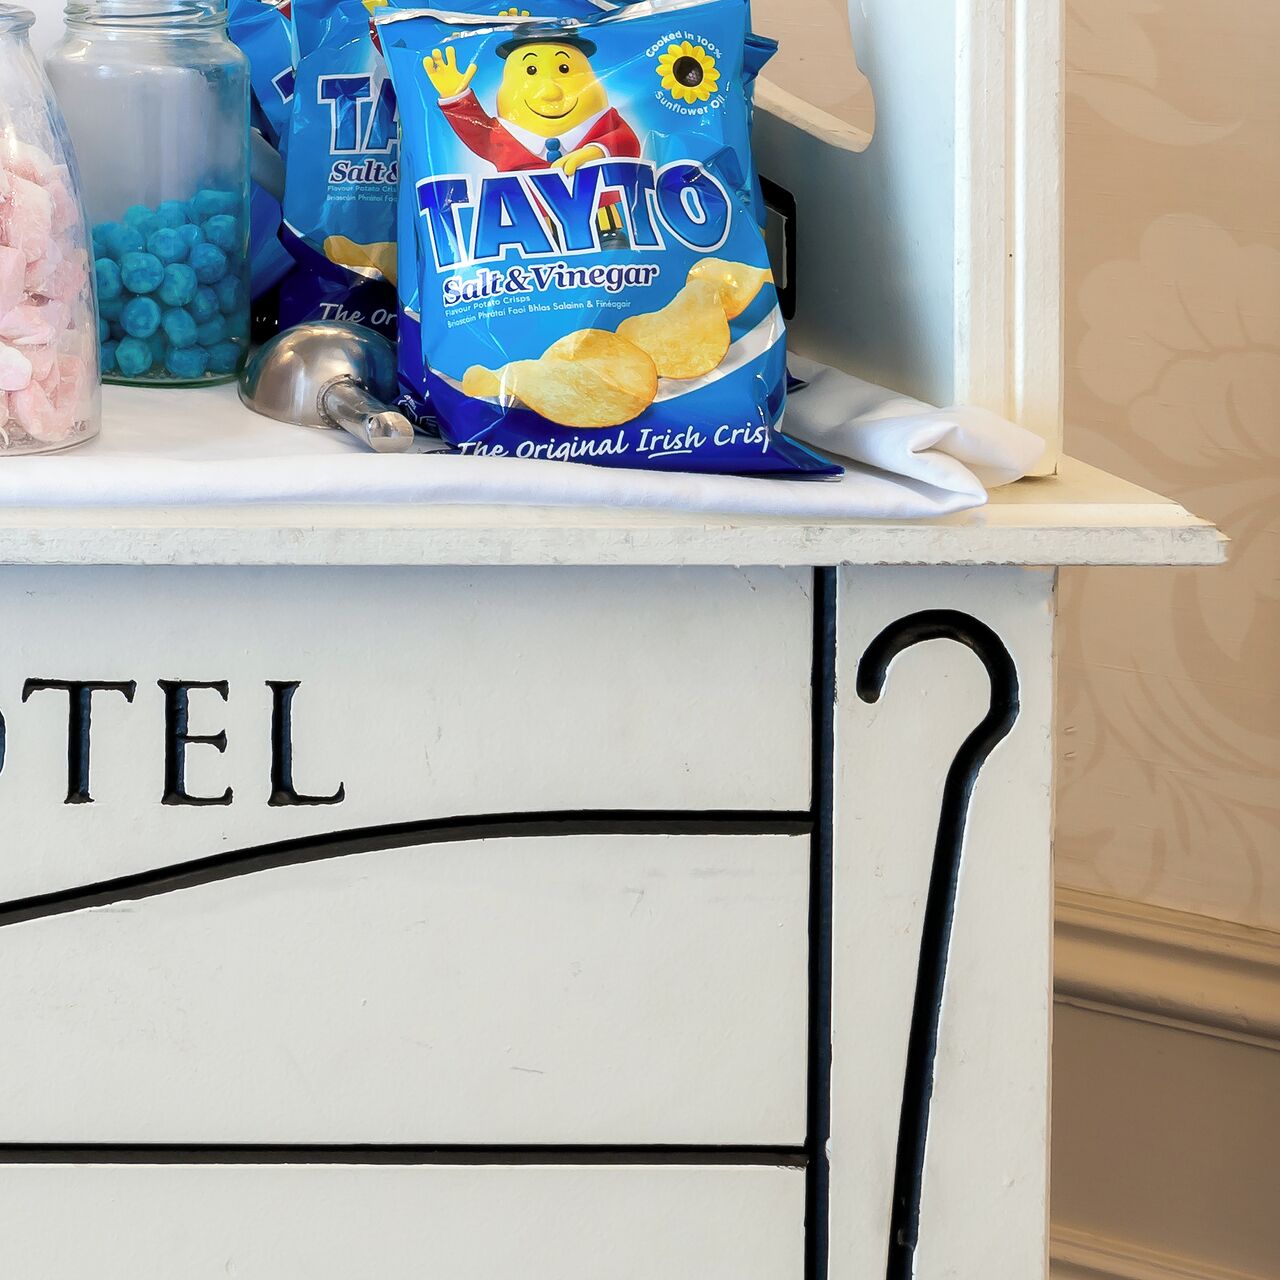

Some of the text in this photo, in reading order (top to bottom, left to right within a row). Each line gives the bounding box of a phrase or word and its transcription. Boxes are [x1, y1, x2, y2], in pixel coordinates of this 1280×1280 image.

[645, 30, 723, 60] Cooked in 100%
[654, 90, 726, 116] Sunflower Oil
[415, 156, 732, 271] TAYTO
[318, 302, 365, 324] The
[444, 294, 531, 318] Flavour Potato Crisps
[508, 306, 527, 317] Faoi
[528, 302, 551, 313] Bhlas
[553, 300, 585, 311] Salainn
[586, 300, 594, 308] &
[456, 440, 509, 458] The
[516, 429, 629, 462] Original
[636, 424, 706, 459] Irish
